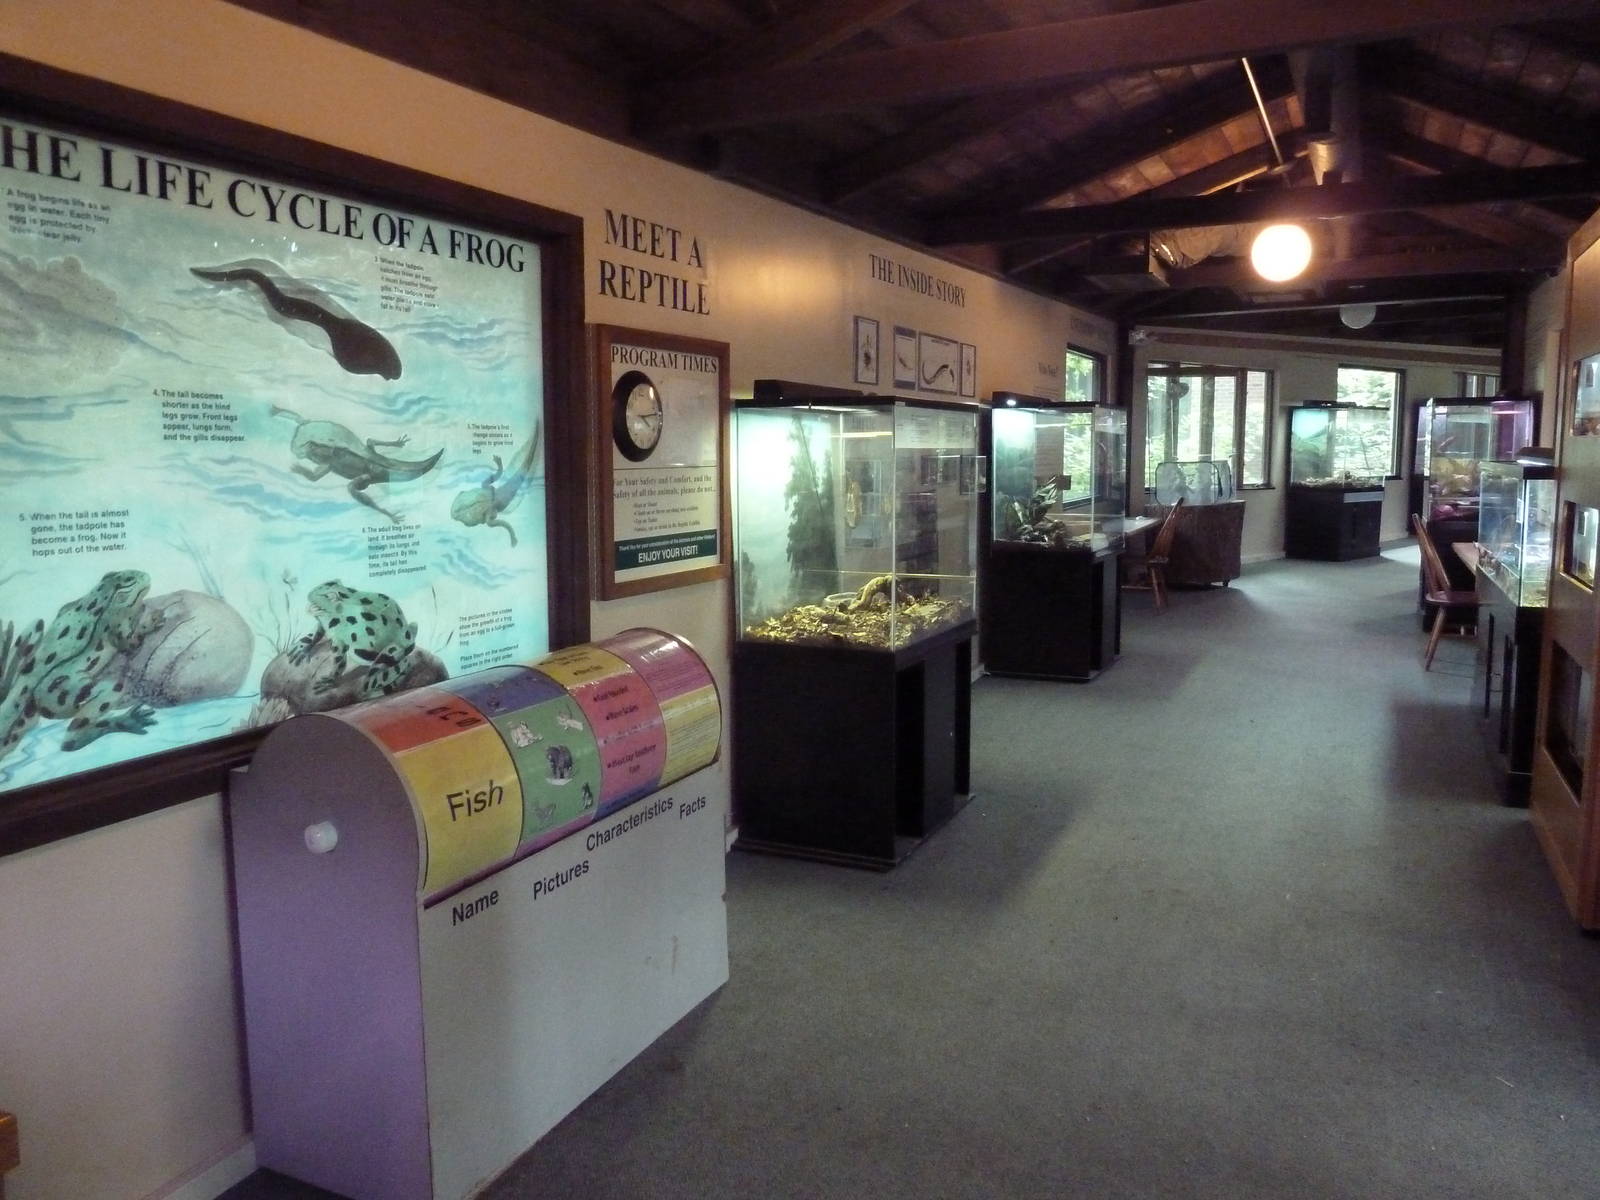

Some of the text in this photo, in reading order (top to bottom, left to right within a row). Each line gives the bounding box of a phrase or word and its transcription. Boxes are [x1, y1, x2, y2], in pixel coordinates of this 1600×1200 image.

[100, 148, 213, 209] LIFE
[228, 179, 364, 241] CYCLE
[373, 213, 415, 248] OF
[420, 224, 440, 256] A
[449, 229, 526, 273] FROG
[605, 208, 703, 268] MEET A
[599, 259, 710, 315] REPTILE
[869, 254, 967, 308] THE INSIDE STORY
[611, 346, 717, 373] PROGRAM TIMES
[162, 390, 175, 398] The
[215, 402, 230, 410] hind
[162, 412, 178, 420] legs
[202, 413, 221, 421] Front
[223, 414, 238, 422] legs
[192, 423, 212, 432] lungs
[193, 434, 208, 442] gills
[30, 513, 56, 521] When
[75, 511, 89, 519] tail
[101, 509, 129, 517] almost
[31, 526, 56, 535] gone,
[76, 522, 107, 531] tadpole
[32, 536, 68, 545] become
[32, 549, 55, 557] hops
[58, 546, 72, 555] out
[75, 545, 84, 553] of
[638, 545, 698, 563] ENJOY YOUR VISIT!
[446, 779, 504, 822] Fish
[586, 795, 674, 852] Characteristics
[679, 794, 706, 820] Facts
[533, 858, 590, 901] Pictures
[452, 889, 499, 926] Name
